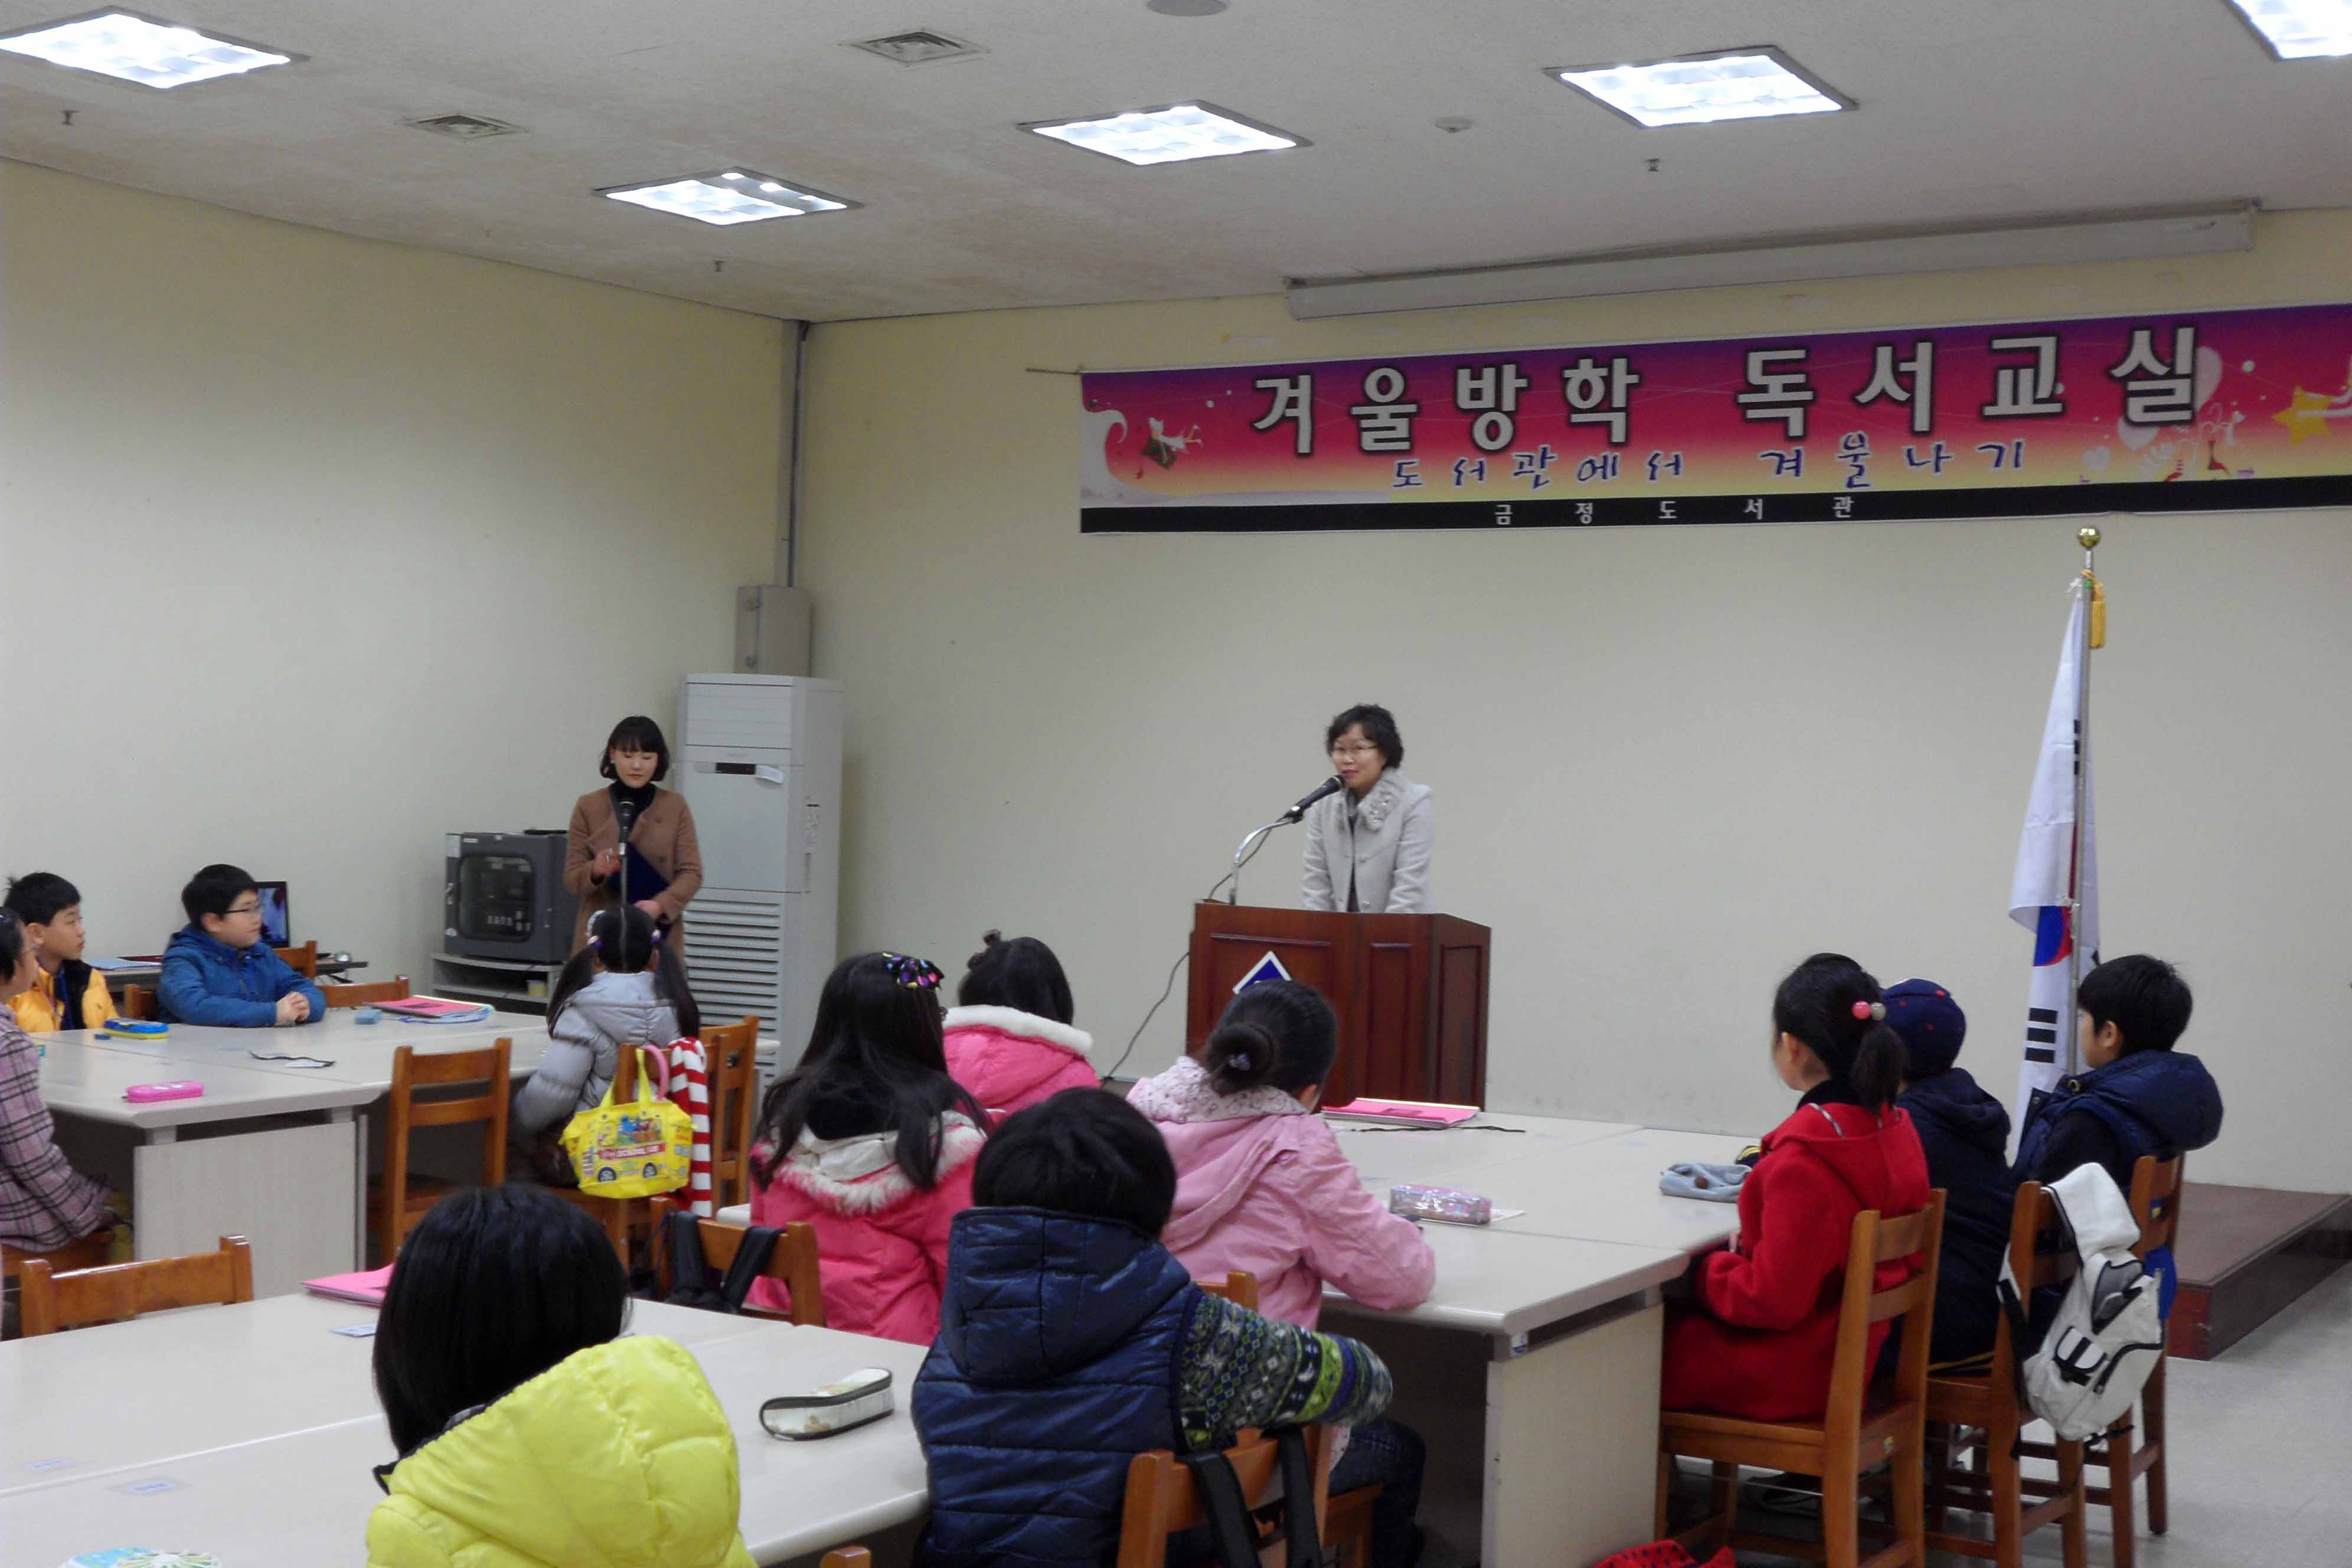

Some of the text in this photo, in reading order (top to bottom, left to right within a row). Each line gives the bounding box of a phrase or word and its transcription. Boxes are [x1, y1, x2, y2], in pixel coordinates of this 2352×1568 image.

[1252, 326, 2196, 454] 겨울방학 독서교실
[1393, 432, 2024, 489] 도서관에서 겨울나기
